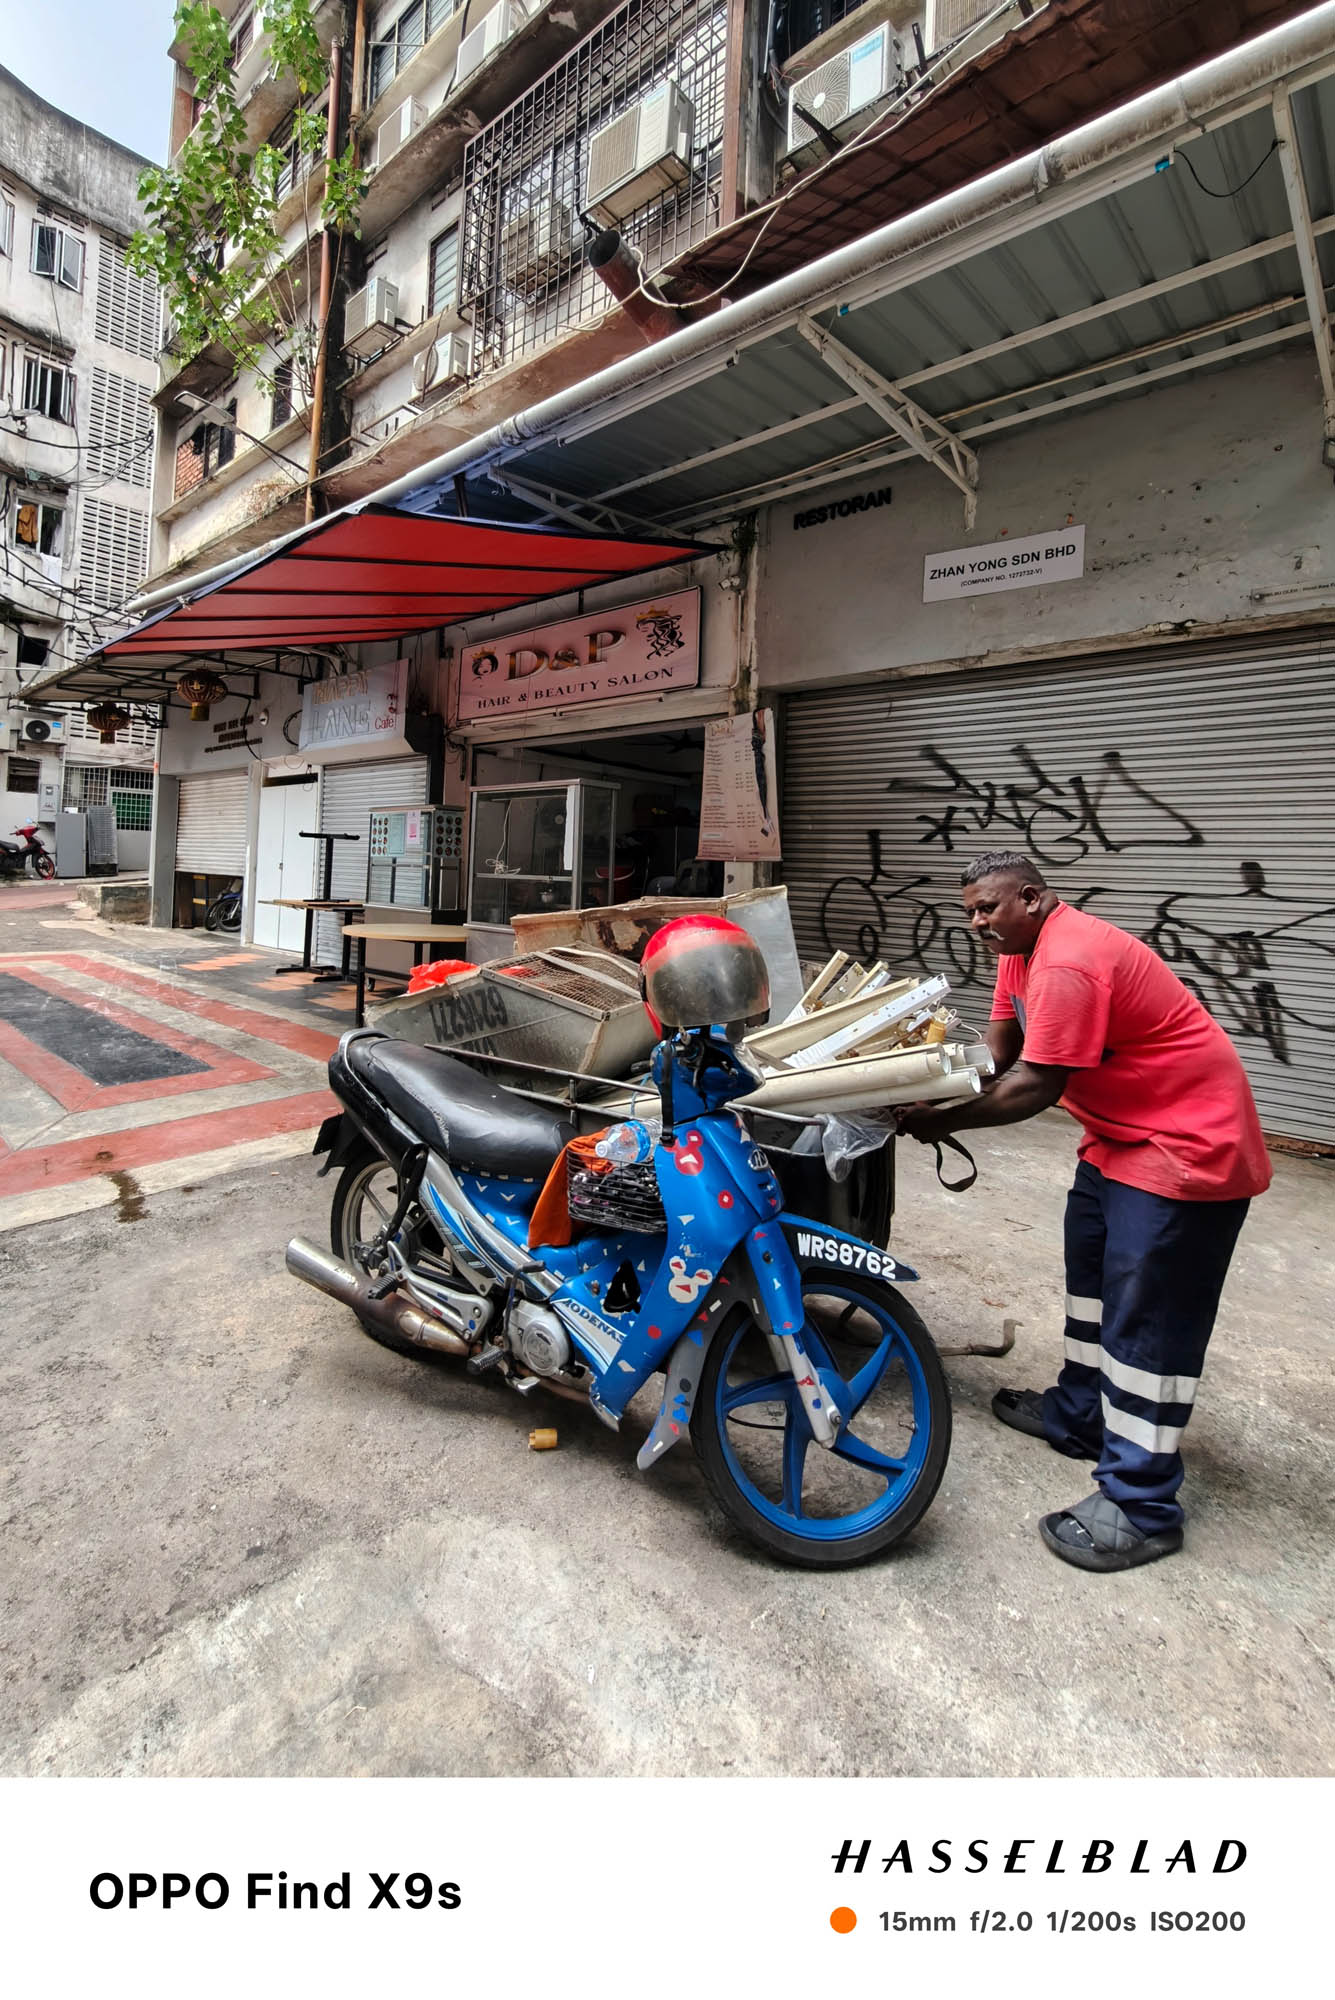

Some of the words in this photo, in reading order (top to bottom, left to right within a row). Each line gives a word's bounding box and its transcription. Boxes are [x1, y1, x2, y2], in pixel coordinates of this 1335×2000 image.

[793, 486, 892, 530] RESTORAN
[929, 565, 965, 580] ZHAN
[968, 557, 1008, 573] YONG
[1011, 551, 1040, 566] SDN
[1045, 543, 1076, 560] BHD
[960, 575, 994, 587] (COMPANY
[504, 629, 627, 682] D&P
[478, 694, 511, 709] HAIR
[517, 692, 529, 702] &
[534, 679, 600, 700] BEAUTY
[607, 667, 673, 688] SALON
[797, 1232, 896, 1280] WRS8762
